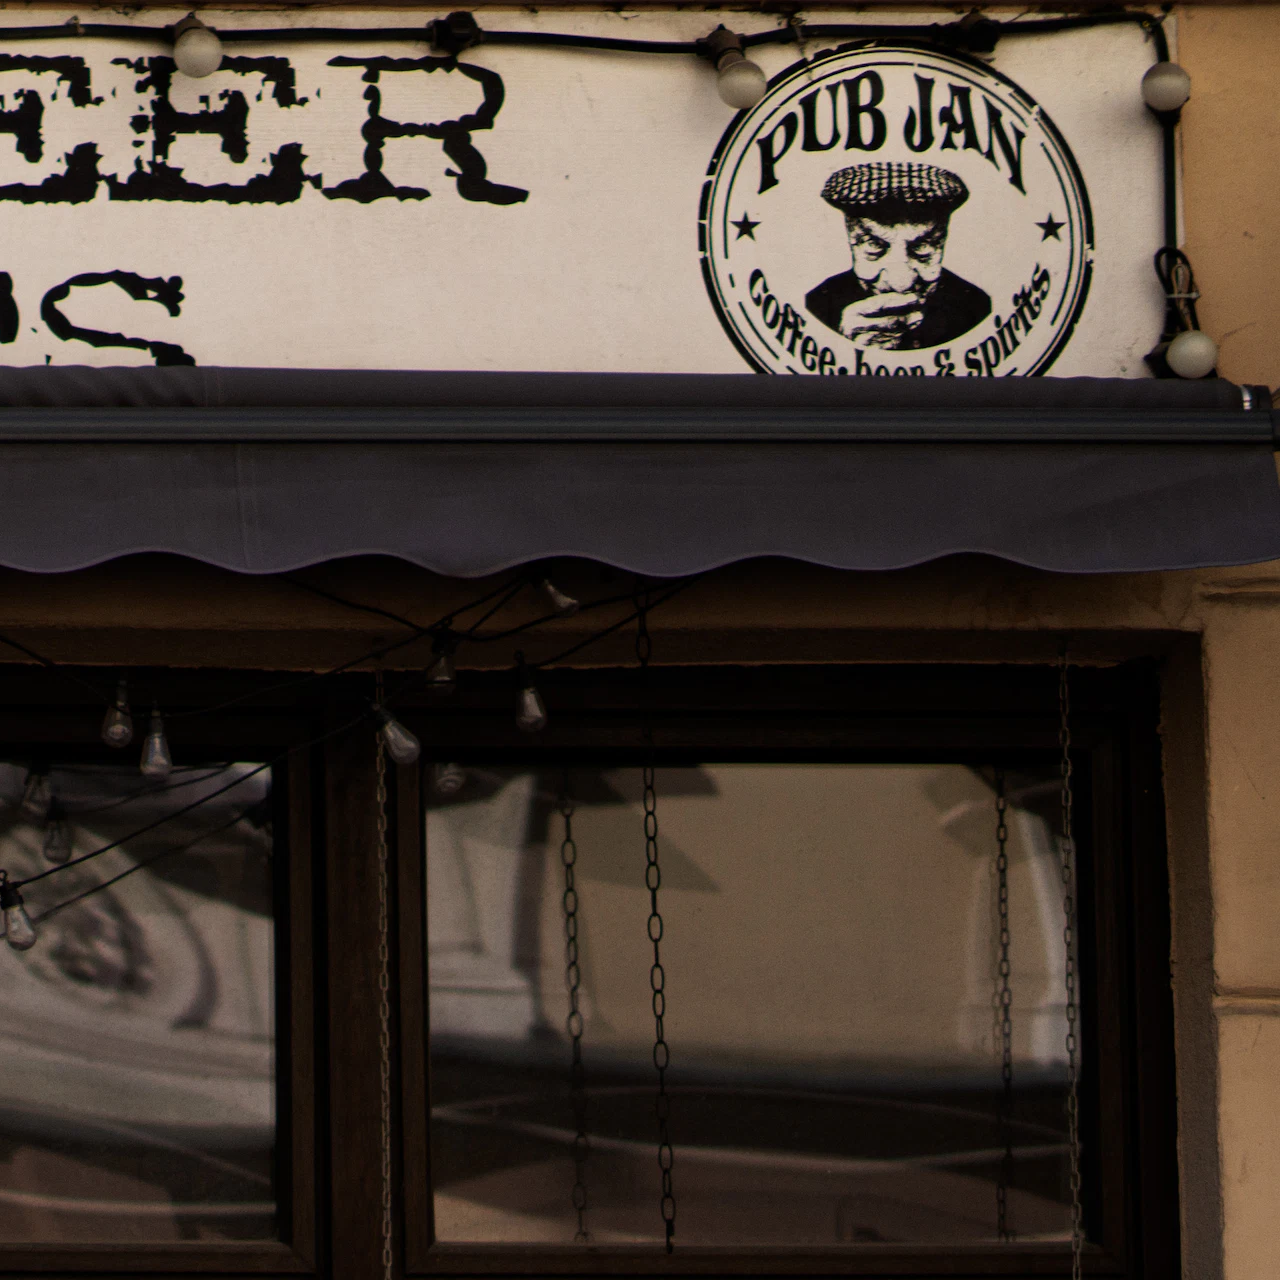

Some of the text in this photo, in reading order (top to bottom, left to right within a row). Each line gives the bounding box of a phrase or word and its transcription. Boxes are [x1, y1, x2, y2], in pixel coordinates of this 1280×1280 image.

[755, 69, 1027, 196] PUB JAN
[747, 267, 837, 375] coffee
[963, 262, 1052, 377] spirits
